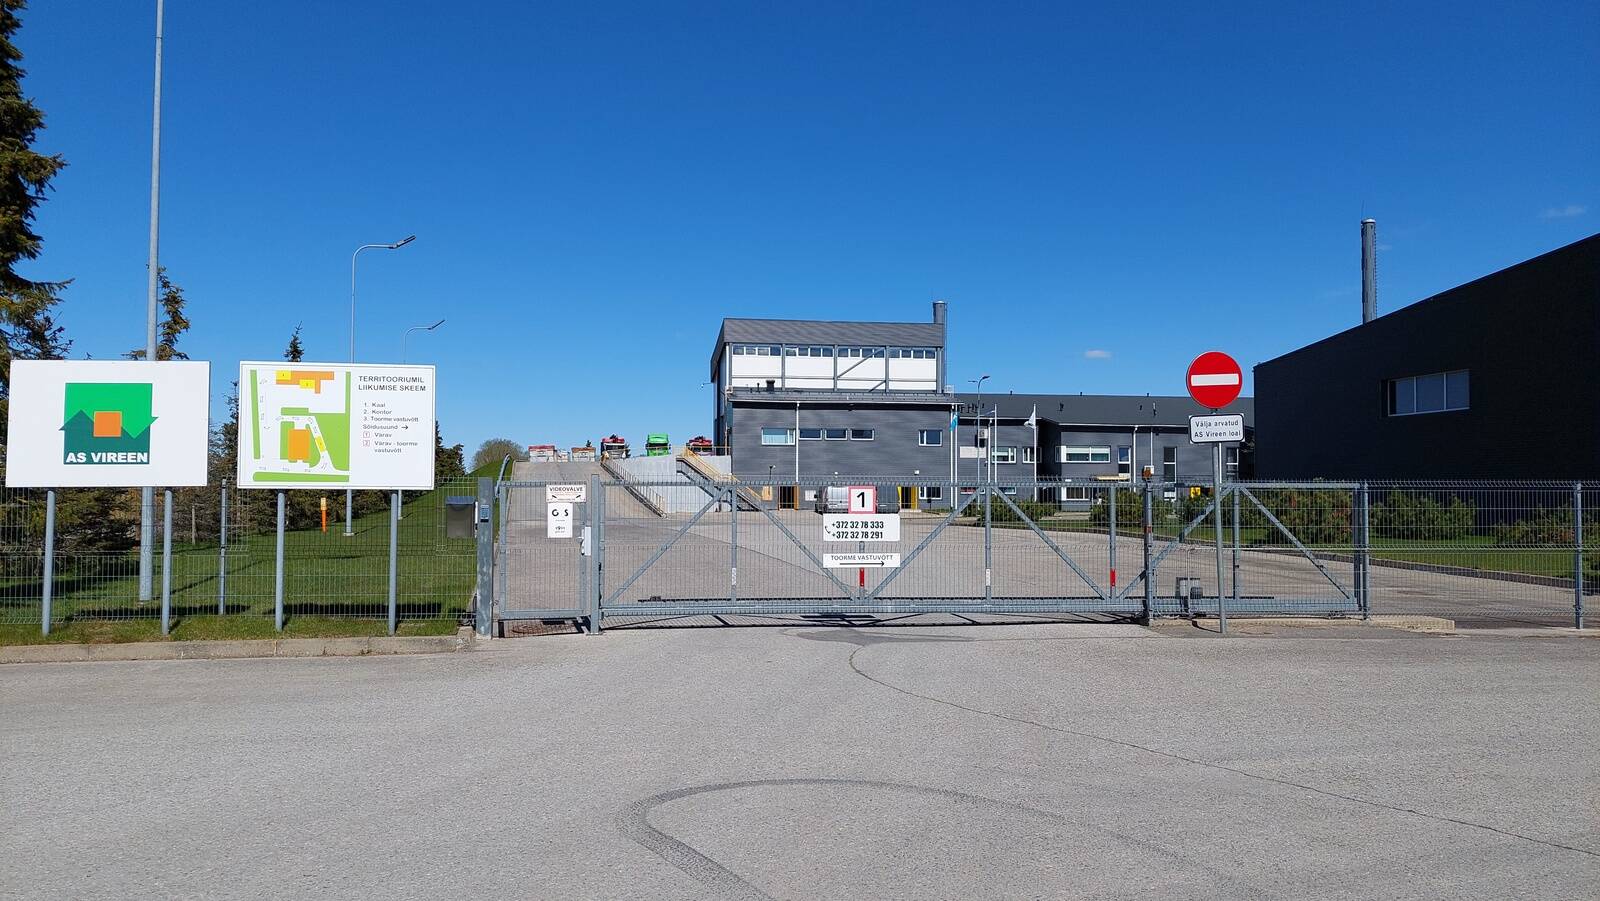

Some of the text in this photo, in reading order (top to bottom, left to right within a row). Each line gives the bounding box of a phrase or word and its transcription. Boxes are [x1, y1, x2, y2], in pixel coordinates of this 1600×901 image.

[358, 375, 425, 383] TERRITOORIUMIL
[66, 452, 148, 462] AS VIREEN
[856, 492, 865, 508] 1
[832, 520, 884, 528] +372 32 78 333
[832, 531, 883, 539] +372 32 78 291
